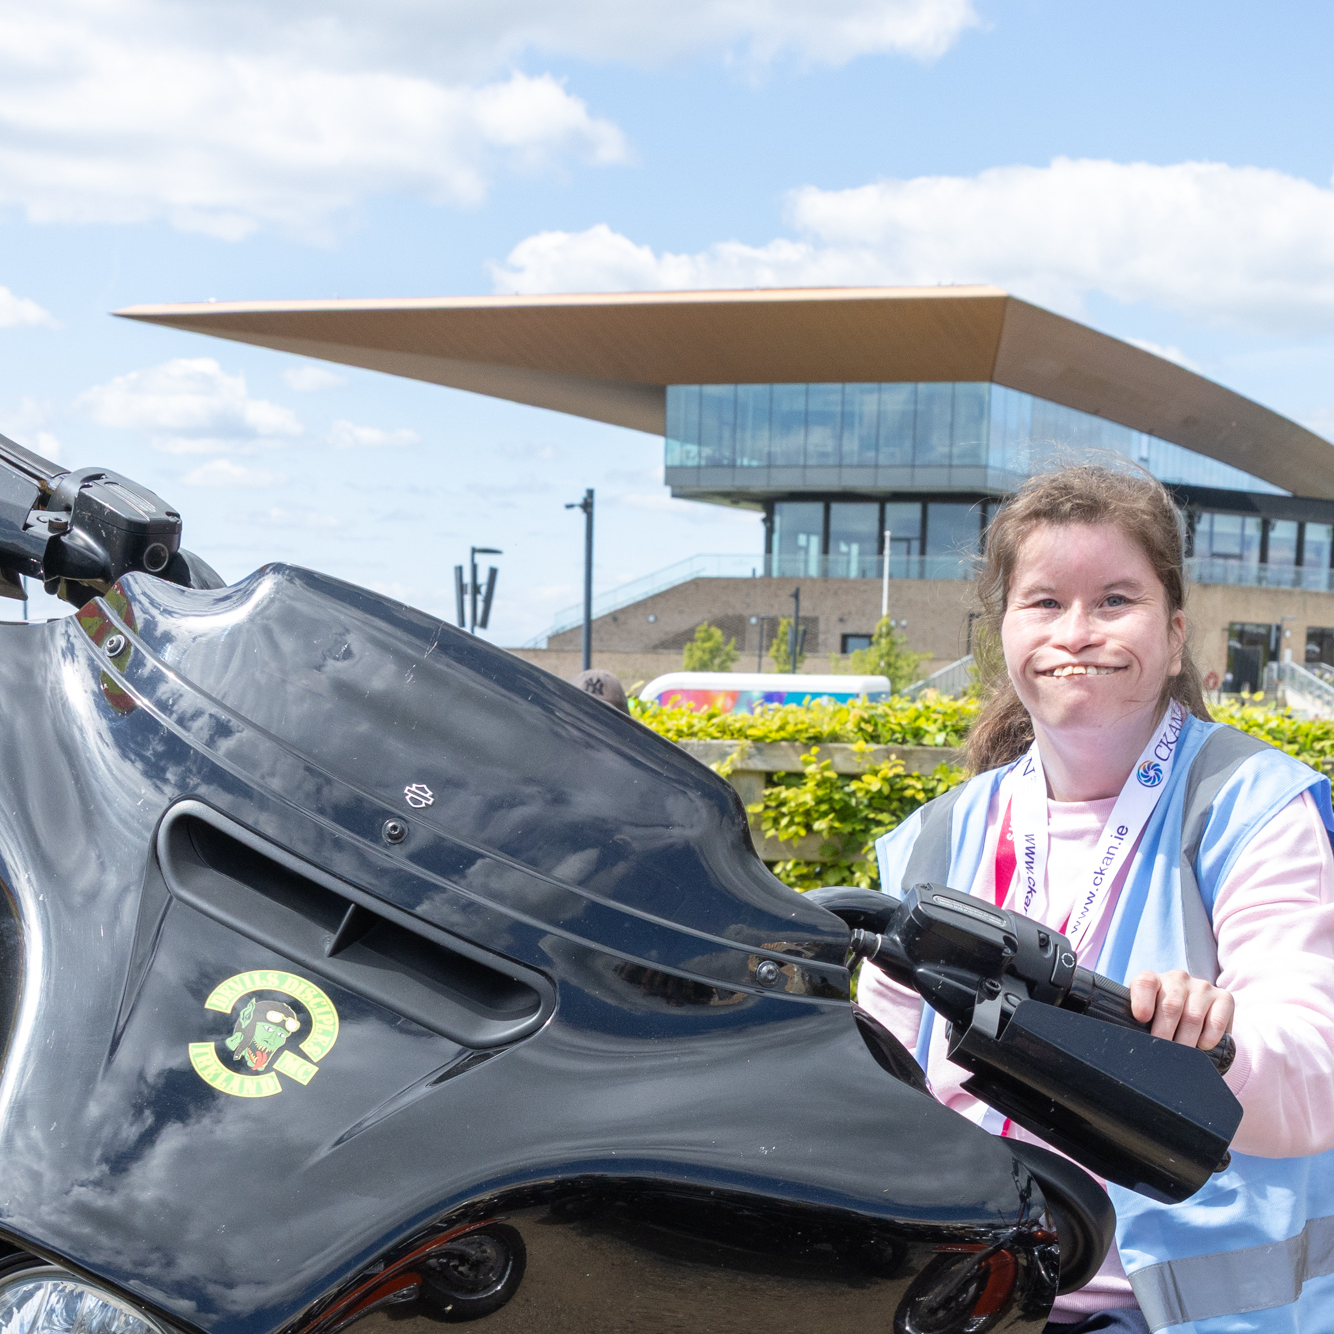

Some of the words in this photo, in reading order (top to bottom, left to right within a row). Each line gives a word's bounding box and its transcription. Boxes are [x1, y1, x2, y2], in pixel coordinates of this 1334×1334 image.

[1070, 824, 1129, 934] www.ckan.ie
[209, 972, 280, 1008] DEVILS
[280, 976, 336, 1058] DISCIPLES
[191, 1046, 276, 1095] IRELAND
[280, 1057, 314, 1080] MC
